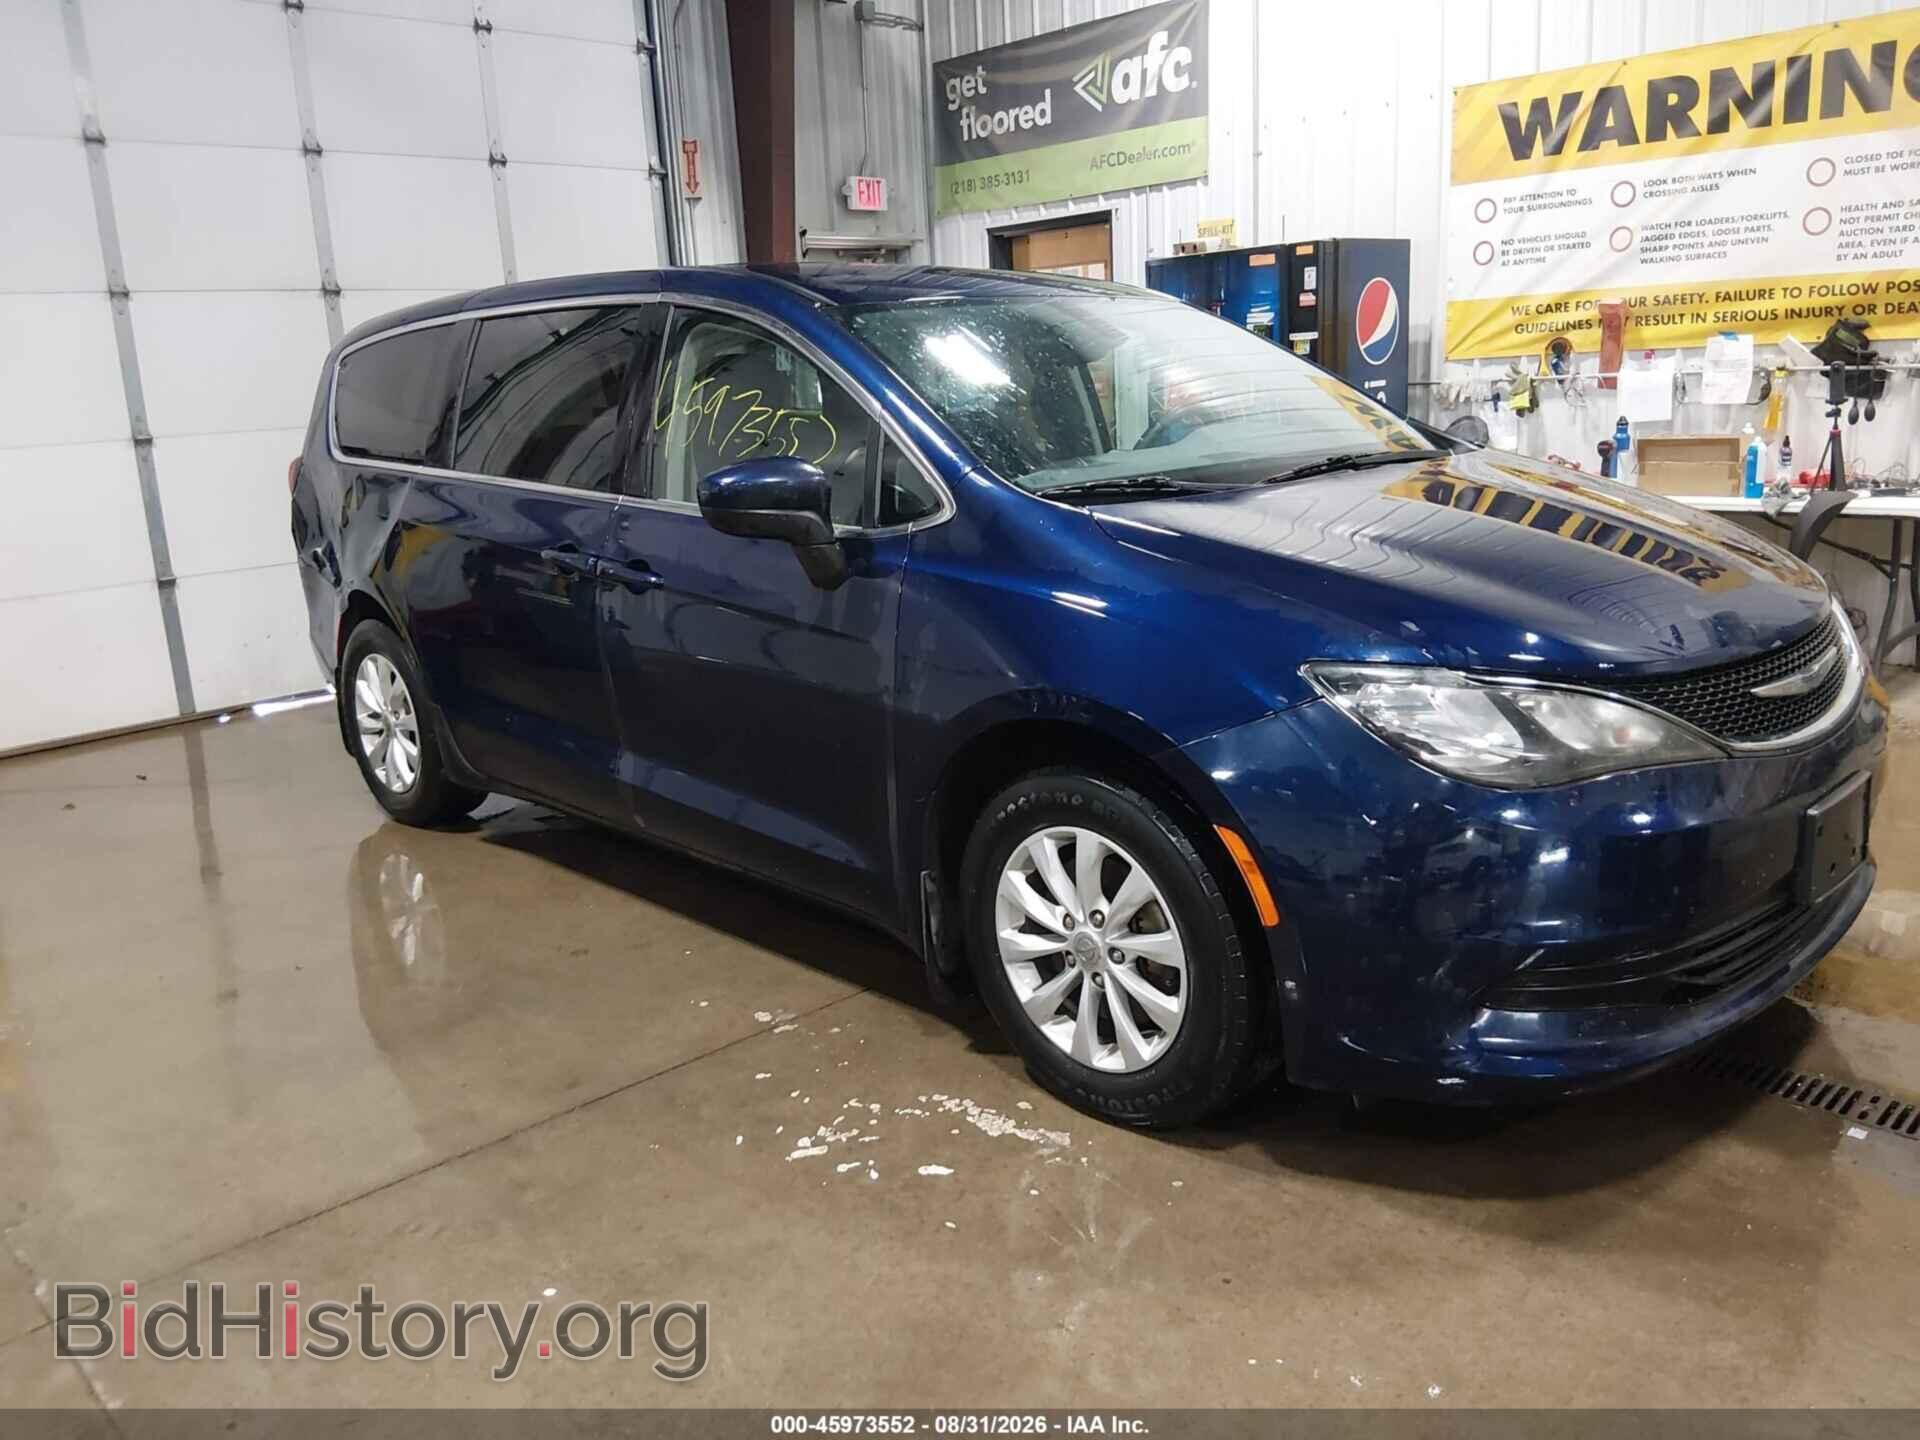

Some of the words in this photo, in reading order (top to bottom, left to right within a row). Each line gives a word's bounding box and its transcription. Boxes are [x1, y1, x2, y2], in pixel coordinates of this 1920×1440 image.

[945, 65, 987, 111] get
[960, 88, 1052, 141] floored
[1844, 153, 1882, 165] CLOSED
[1886, 150, 1904, 160] TOE
[1643, 178, 1668, 188] LOOK
[1671, 175, 1695, 185] BOTH
[1698, 171, 1724, 181] WAYS
[1726, 167, 1757, 178] WHEN
[1843, 166, 1871, 177] MUST
[1874, 165, 1886, 174] BE
[951, 175, 977, 196] (218)
[980, 169, 1031, 191] 385-3131
[858, 179, 881, 207] EXIT
[1519, 191, 1563, 202] ATTENTION
[1566, 188, 1577, 197] TO
[1643, 186, 1688, 199] CROSSING
[1690, 183, 1720, 193] AISLES
[1503, 206, 1524, 214] YOUR
[1526, 198, 1592, 212] SURROUNDINGS
[1840, 202, 1878, 213] HEALTH
[1881, 200, 1905, 210] AND
[1641, 222, 1671, 232] WATCH
[1674, 220, 1692, 229] FOR
[1840, 217, 1861, 226] NOT
[1863, 213, 1901, 223] PERMIT
[1501, 238, 1515, 246] NO
[1517, 234, 1551, 245] VEHICLES
[1554, 231, 1587, 241] SHOULD
[1640, 232, 1675, 243] JAGGED
[1711, 227, 1741, 237] LOOSE
[1838, 226, 1884, 238] AUCTION
[1888, 224, 1916, 234] YARD
[1501, 249, 1510, 257] BE
[1512, 247, 1541, 256] DRIVEN
[1543, 244, 1555, 253] OR
[1557, 241, 1592, 251] STARTED
[1640, 245, 1669, 254] SHARP
[1672, 241, 1705, 252] POINTS
[1707, 239, 1728, 248] AND
[1730, 235, 1769, 246] UNEVEN
[1870, 237, 1897, 247] EVEN
[1900, 236, 1909, 245] IF
[1512, 256, 1546, 266] ANYTIME
[1640, 255, 1682, 265] WALKING
[1685, 250, 1728, 262] SURFACES
[1836, 254, 1849, 262] BY
[1852, 251, 1868, 261] AN
[1871, 249, 1904, 260] ADULT
[1511, 304, 1531, 316] WE
[1535, 300, 1570, 314] CARE
[1620, 295, 1648, 309] UR
[1653, 292, 1709, 307] SAFETY.
[1715, 288, 1775, 303] FAILURE
[1781, 286, 1803, 299] TO
[1808, 282, 1880, 298] FOLLOW
[1886, 279, 1920, 294] POS
[1514, 318, 1593, 335] GUIDELINES
[1634, 312, 1686, 327] RESULT
[1690, 311, 1707, 324] IN
[1713, 308, 1779, 324] SERIOUS
[1784, 304, 1845, 320] INJURY
[1852, 303, 1877, 316] OR
[1884, 301, 1920, 315] DEA
